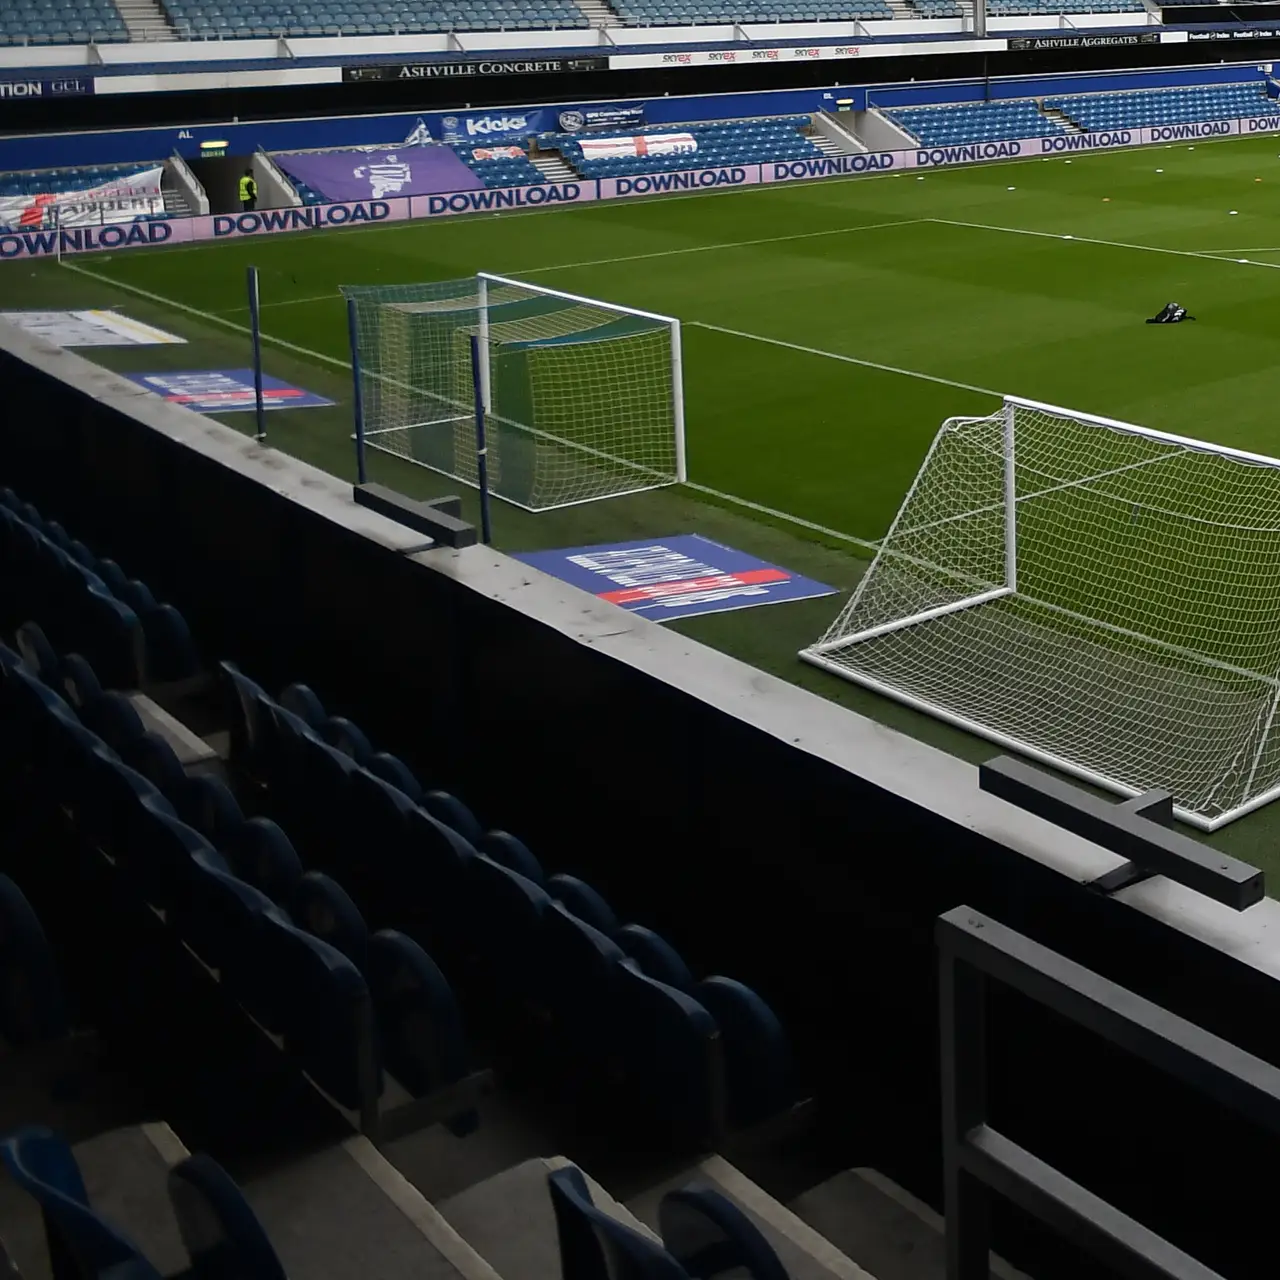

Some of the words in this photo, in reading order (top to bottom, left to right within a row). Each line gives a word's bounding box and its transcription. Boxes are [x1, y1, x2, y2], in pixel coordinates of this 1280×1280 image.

[1034, 38, 1080, 49] ASHVILLE
[1081, 36, 1138, 47] AGGREGATES
[399, 65, 476, 79] ASHVILLE
[478, 61, 562, 76] CONCRETE
[178, 130, 193, 140] AL
[466, 116, 528, 136] Kicks
[1151, 122, 1230, 141] DOWNLOAD
[1041, 130, 1132, 152] DOWNLOAD
[916, 141, 1021, 166] DOWNLOAD
[774, 154, 894, 180] DOWNLOAD
[616, 168, 746, 195] DOWNLOAD
[428, 184, 581, 215] DOWNLOAD
[213, 201, 391, 236] DOWNLOAD
